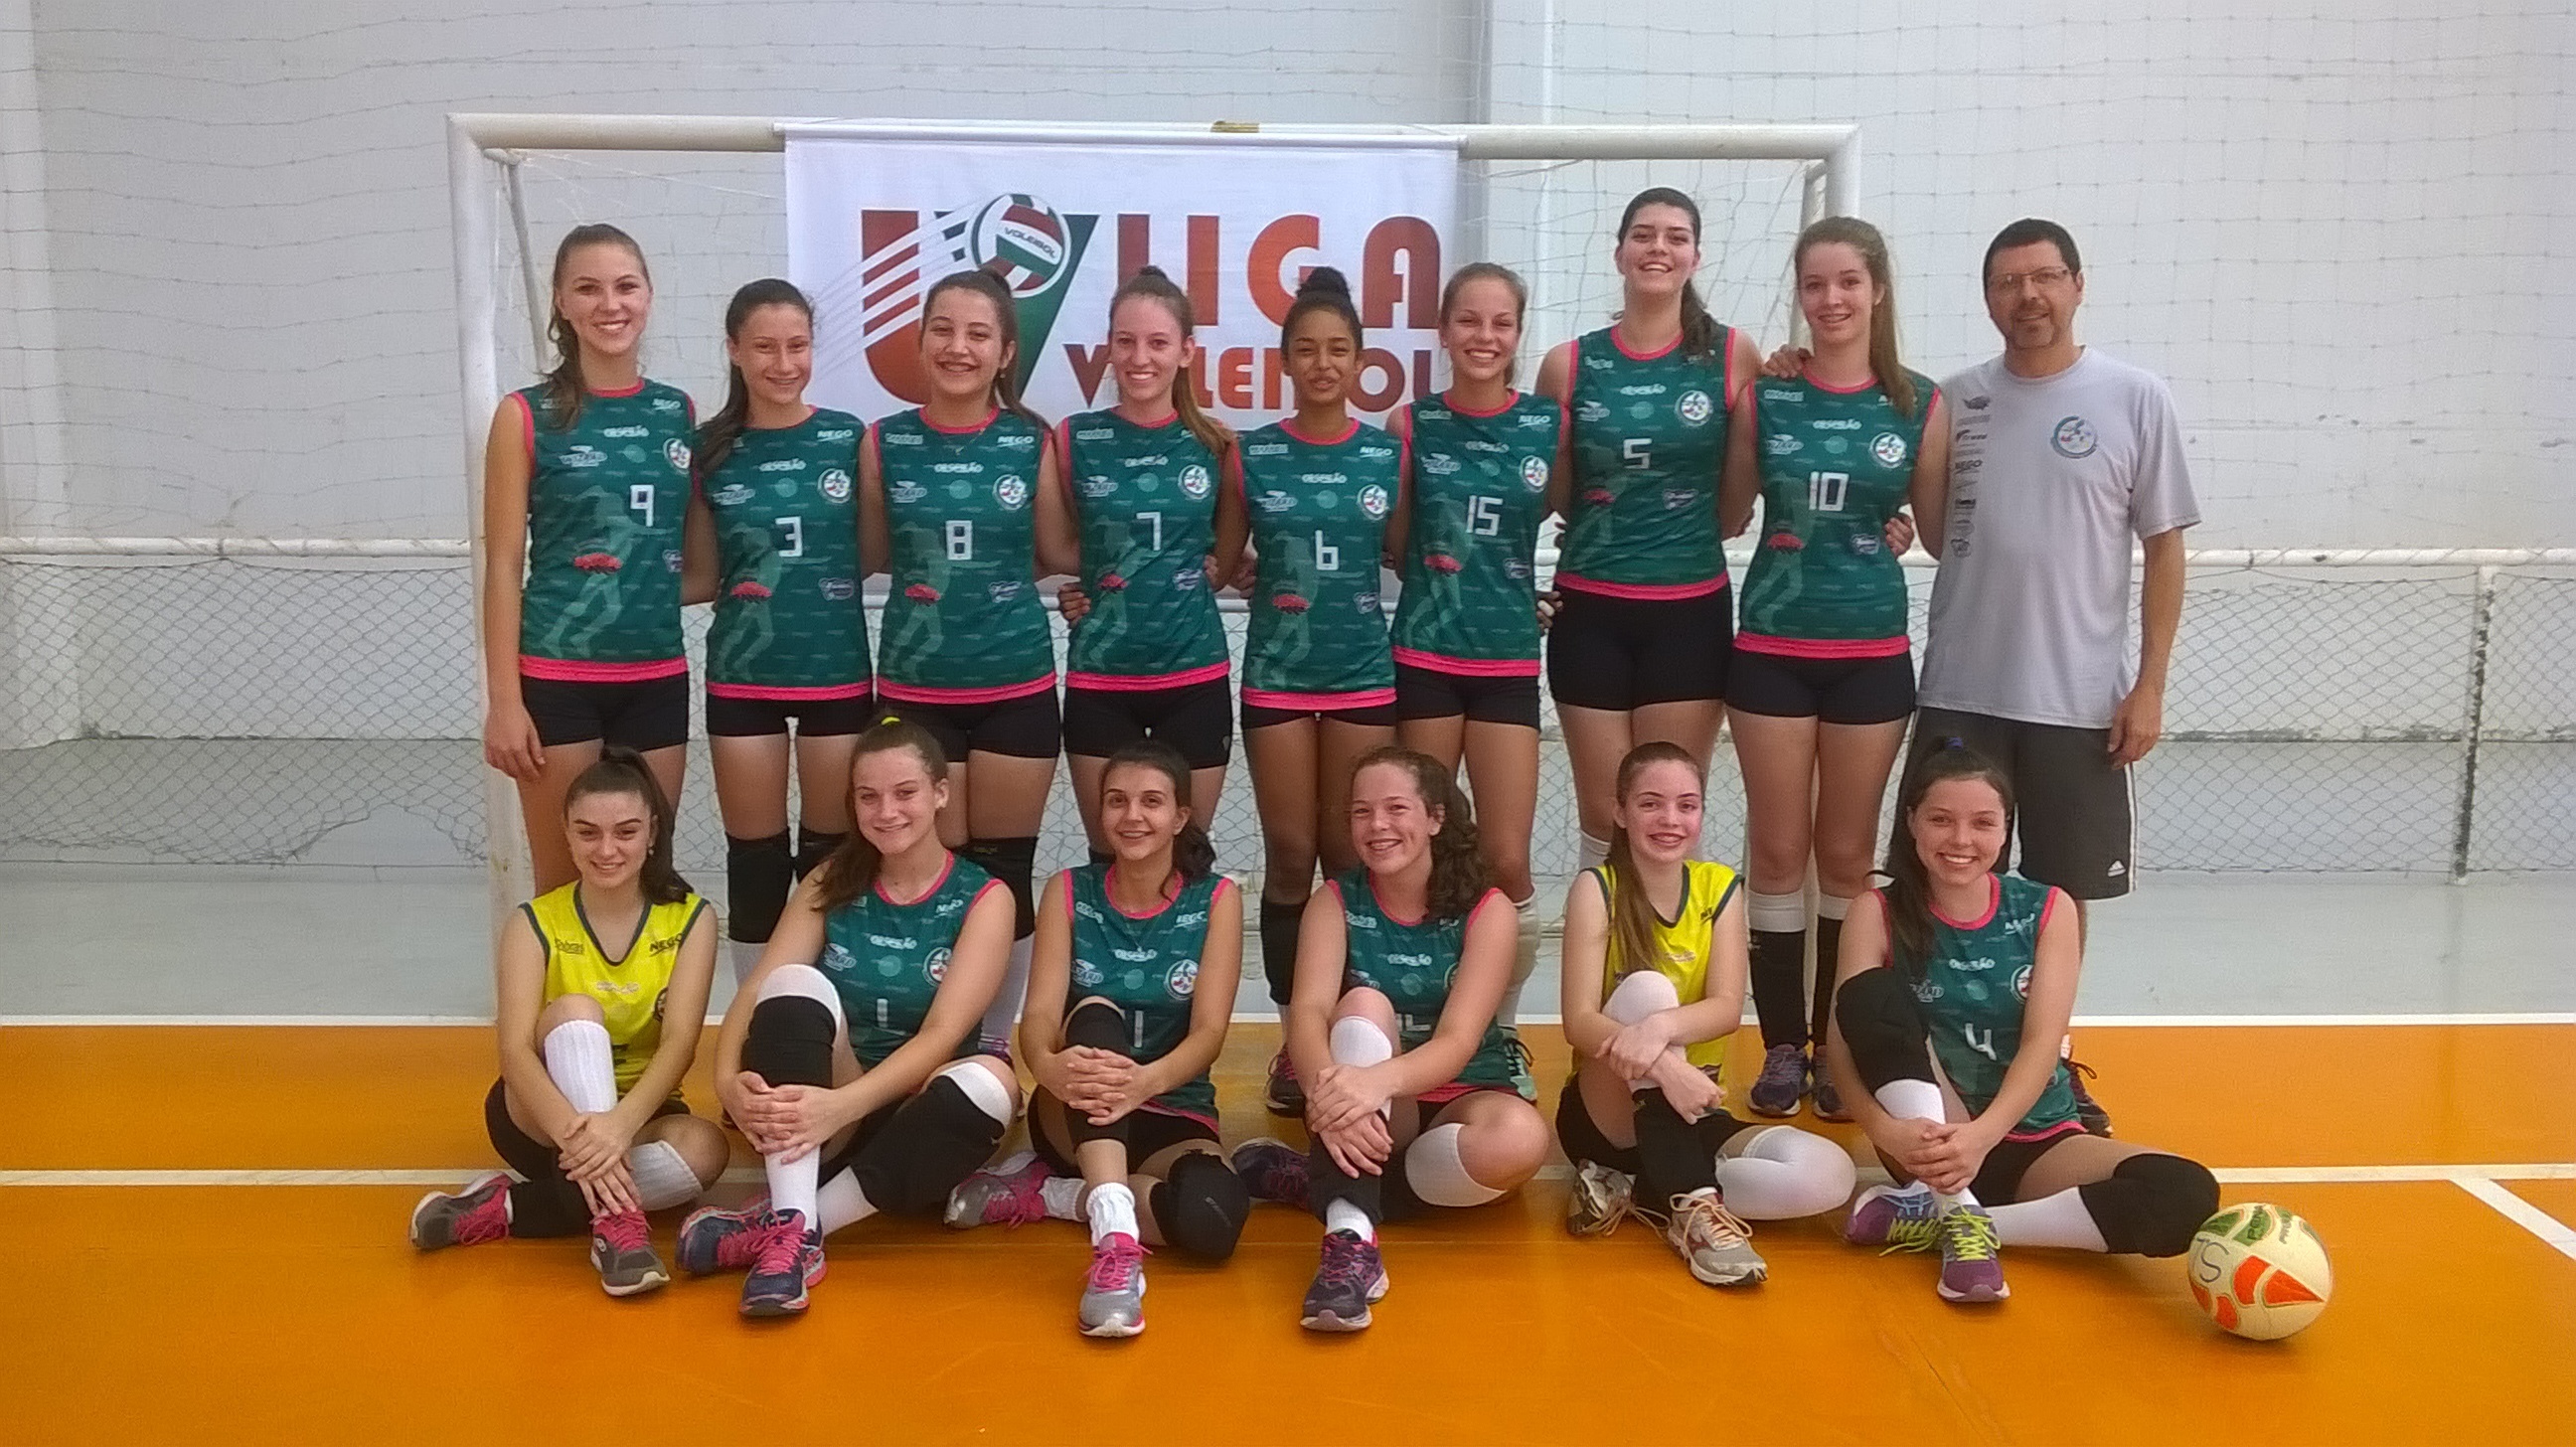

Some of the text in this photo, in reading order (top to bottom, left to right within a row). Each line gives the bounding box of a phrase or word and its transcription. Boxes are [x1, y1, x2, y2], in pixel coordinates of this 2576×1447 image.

[1004, 227, 1057, 266] VOLEIBOL
[998, 436, 1036, 446] NEGO
[1624, 438, 1653, 469] 5
[630, 484, 655, 527] 9
[1809, 471, 1850, 512] 10
[1136, 511, 1162, 552] 7
[1465, 494, 1504, 537] 15
[775, 516, 803, 558] 3
[946, 520, 973, 561] 8
[1315, 530, 1340, 571] 6
[1965, 1022, 1998, 1061] 4
